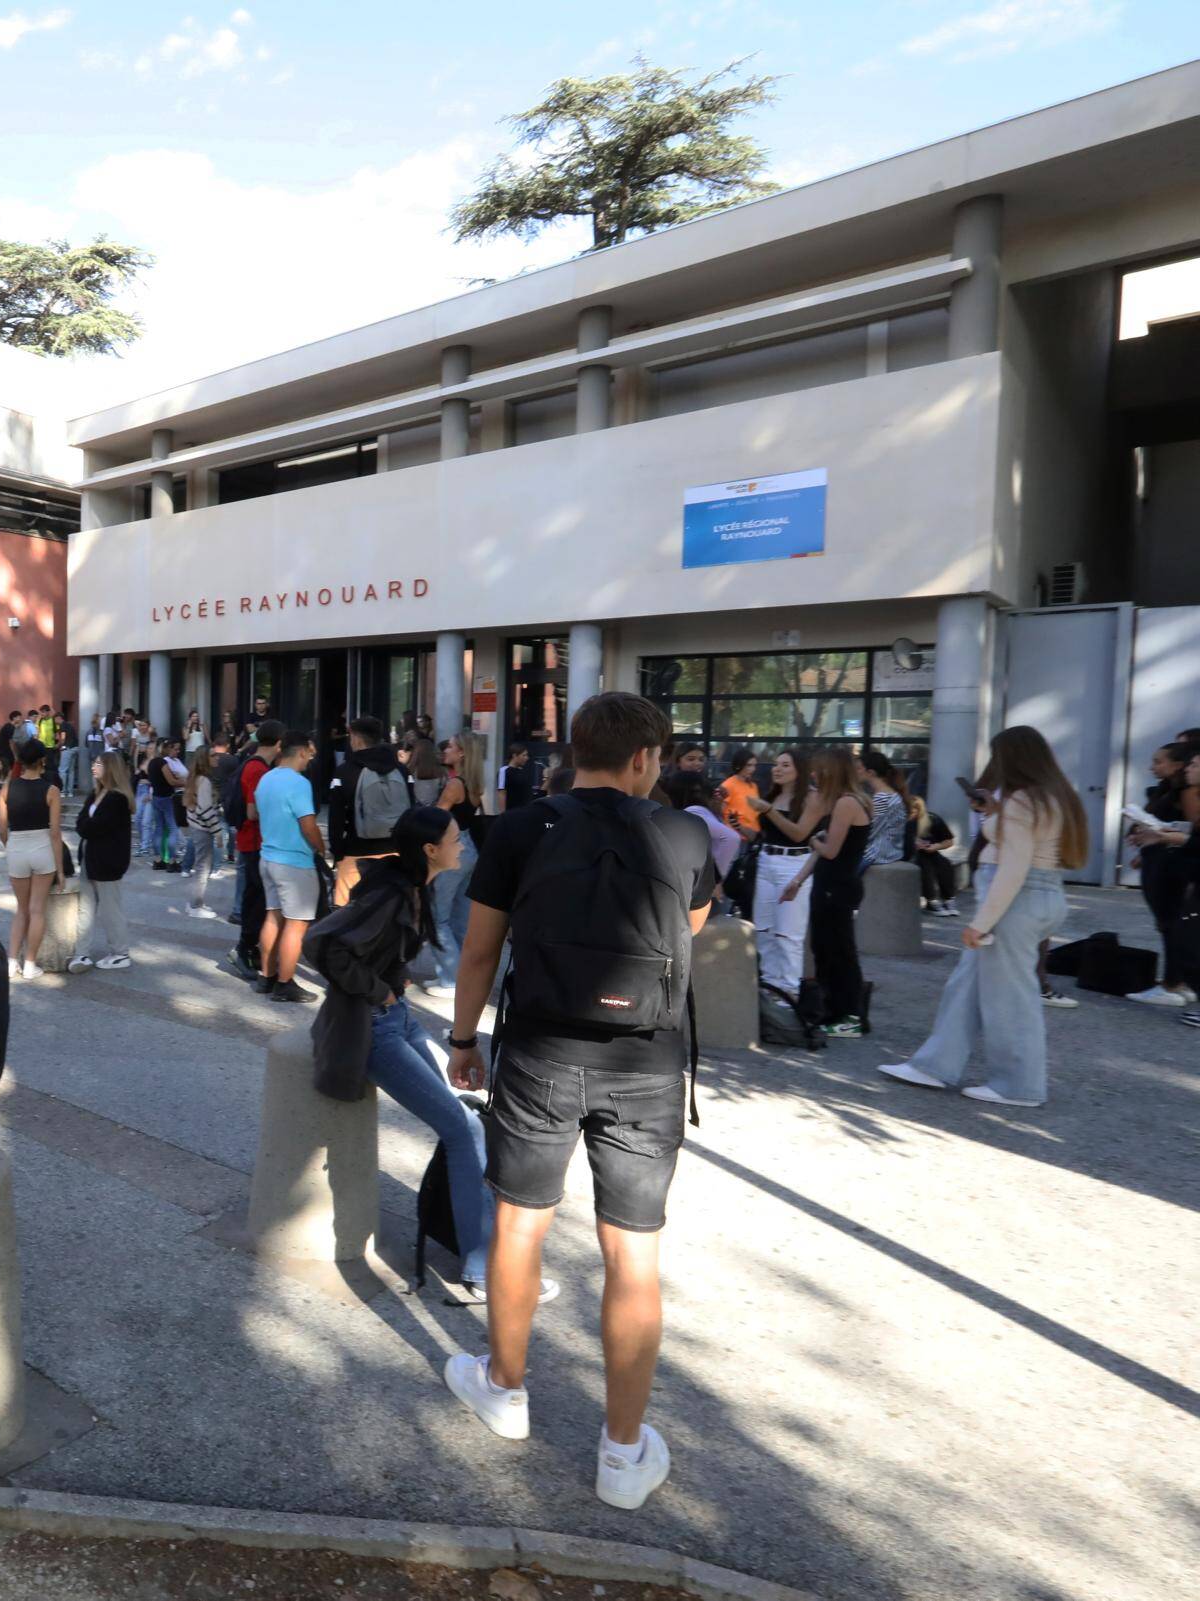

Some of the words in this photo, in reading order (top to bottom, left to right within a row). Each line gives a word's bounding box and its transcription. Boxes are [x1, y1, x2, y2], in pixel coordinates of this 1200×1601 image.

[713, 520, 741, 532] LYCÉE
[720, 527, 782, 540] RAYNOUARD
[152, 598, 226, 622] LYCÉE
[240, 578, 429, 613] RAYNOUARD
